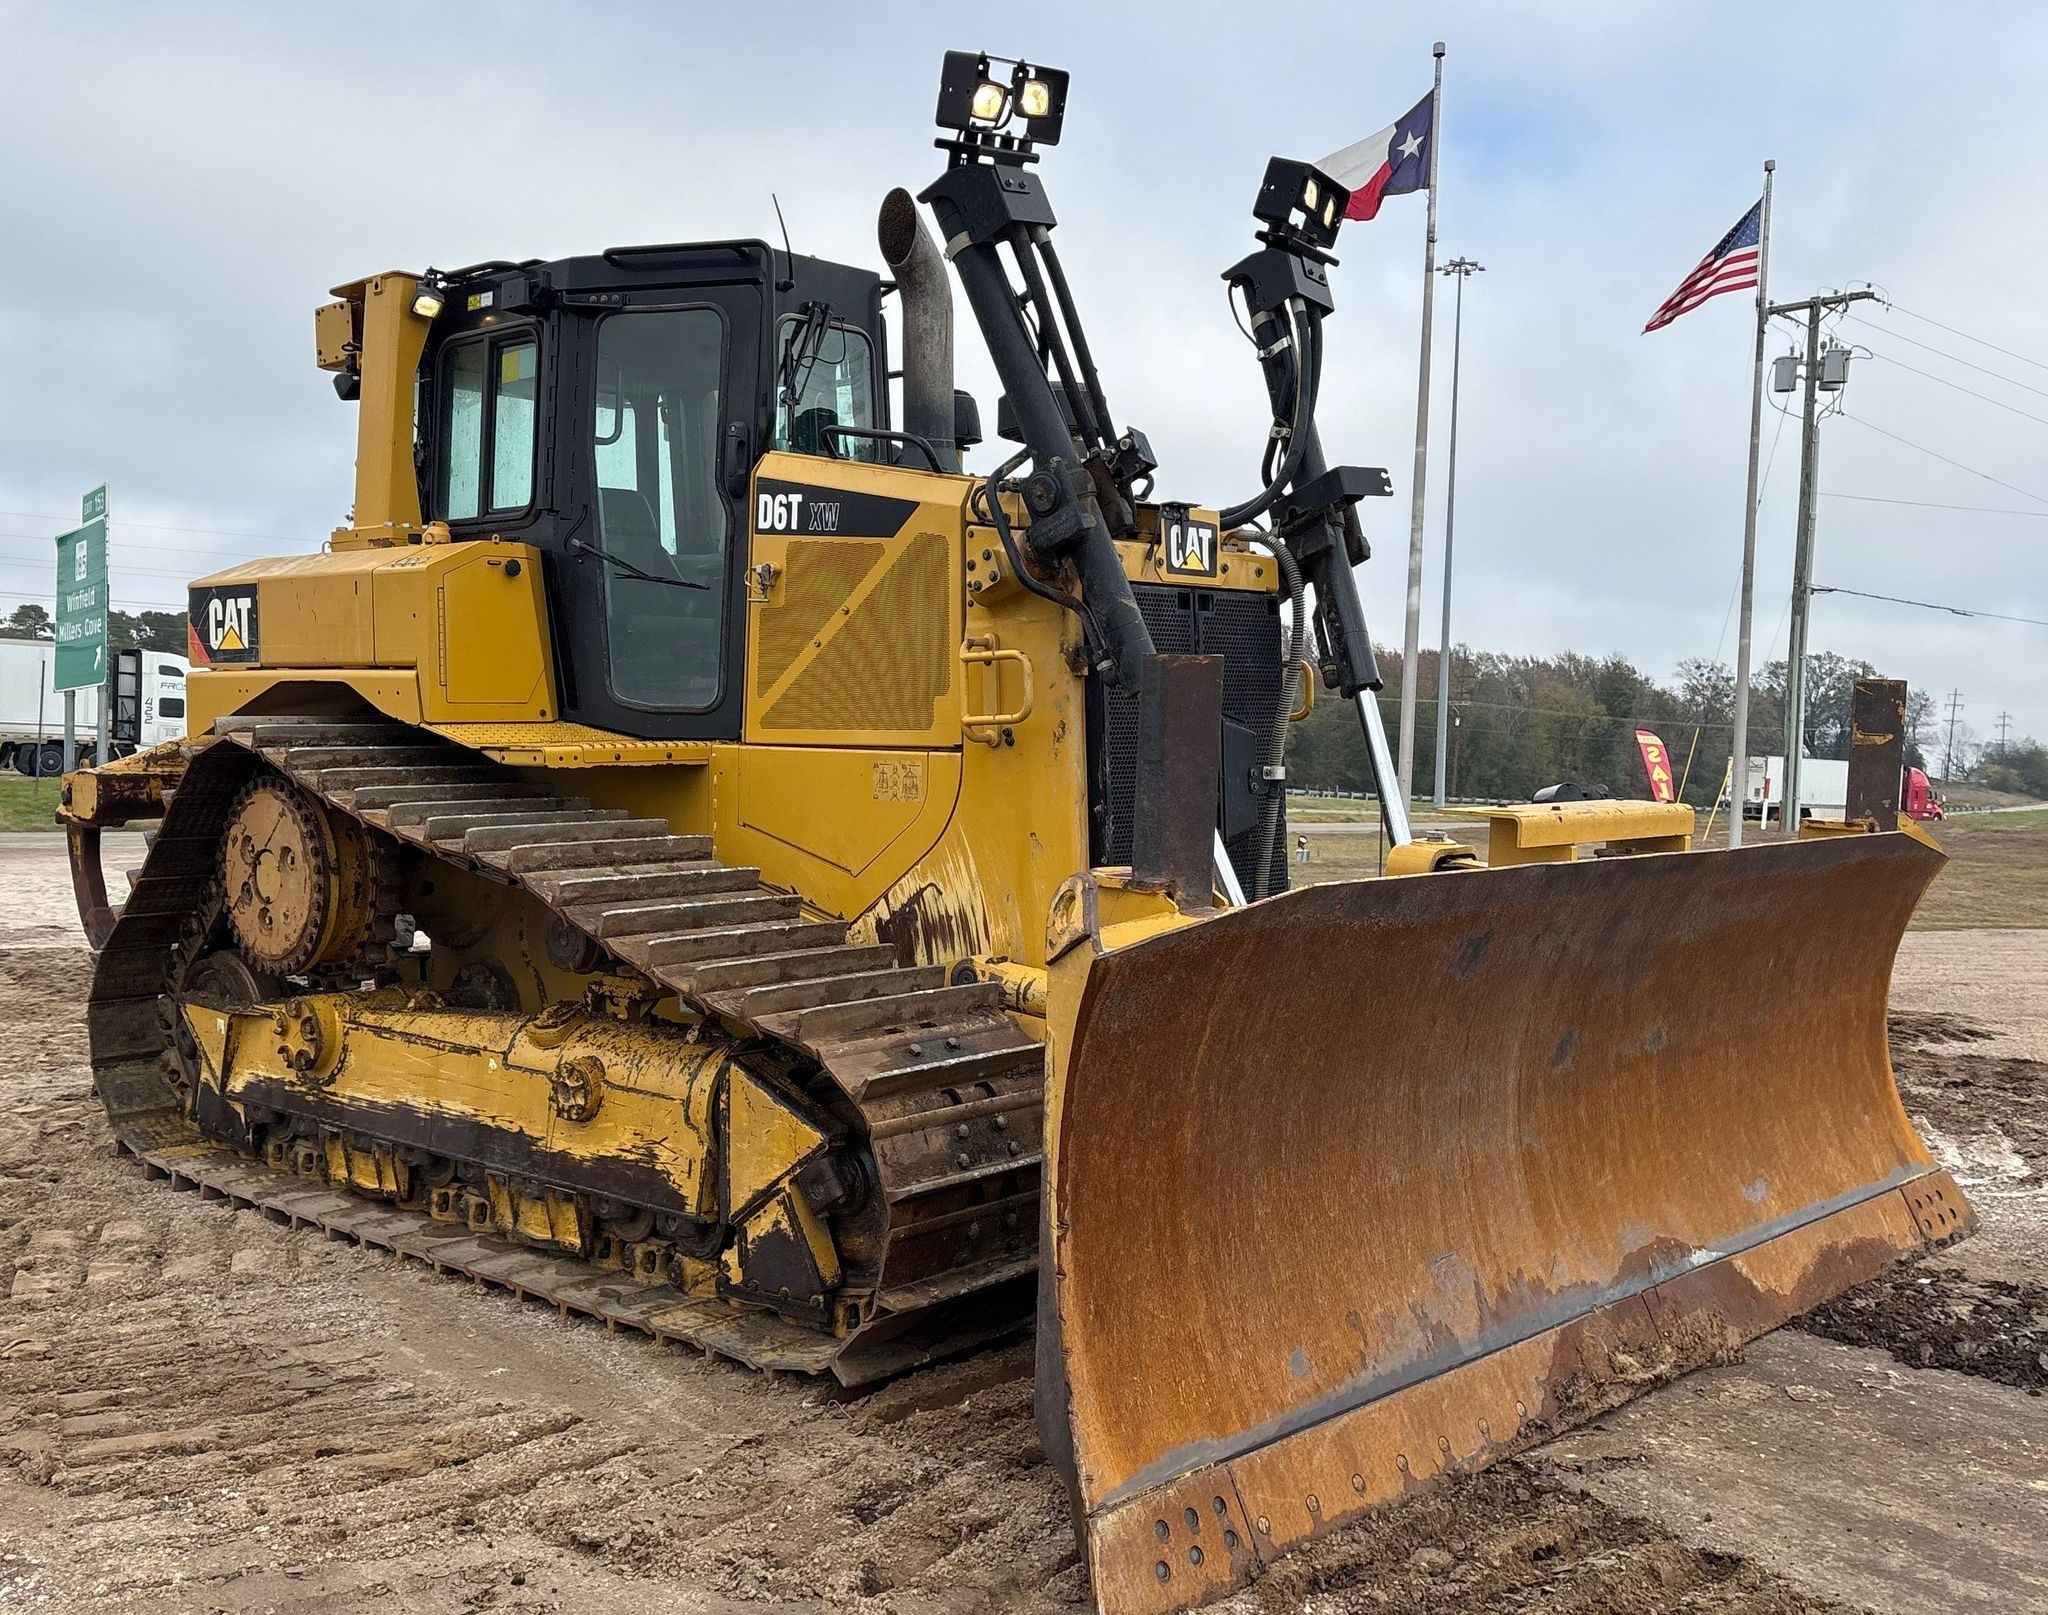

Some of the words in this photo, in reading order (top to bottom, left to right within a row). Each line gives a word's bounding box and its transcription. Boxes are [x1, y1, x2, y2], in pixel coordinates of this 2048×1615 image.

[758, 493, 803, 530] D6T
[808, 502, 840, 531] XW
[1170, 524, 1212, 572] CAT
[66, 586, 95, 613] Winfield
[59, 622, 82, 642] Millers
[84, 617, 102, 637] Cove
[209, 597, 252, 650] CAT
